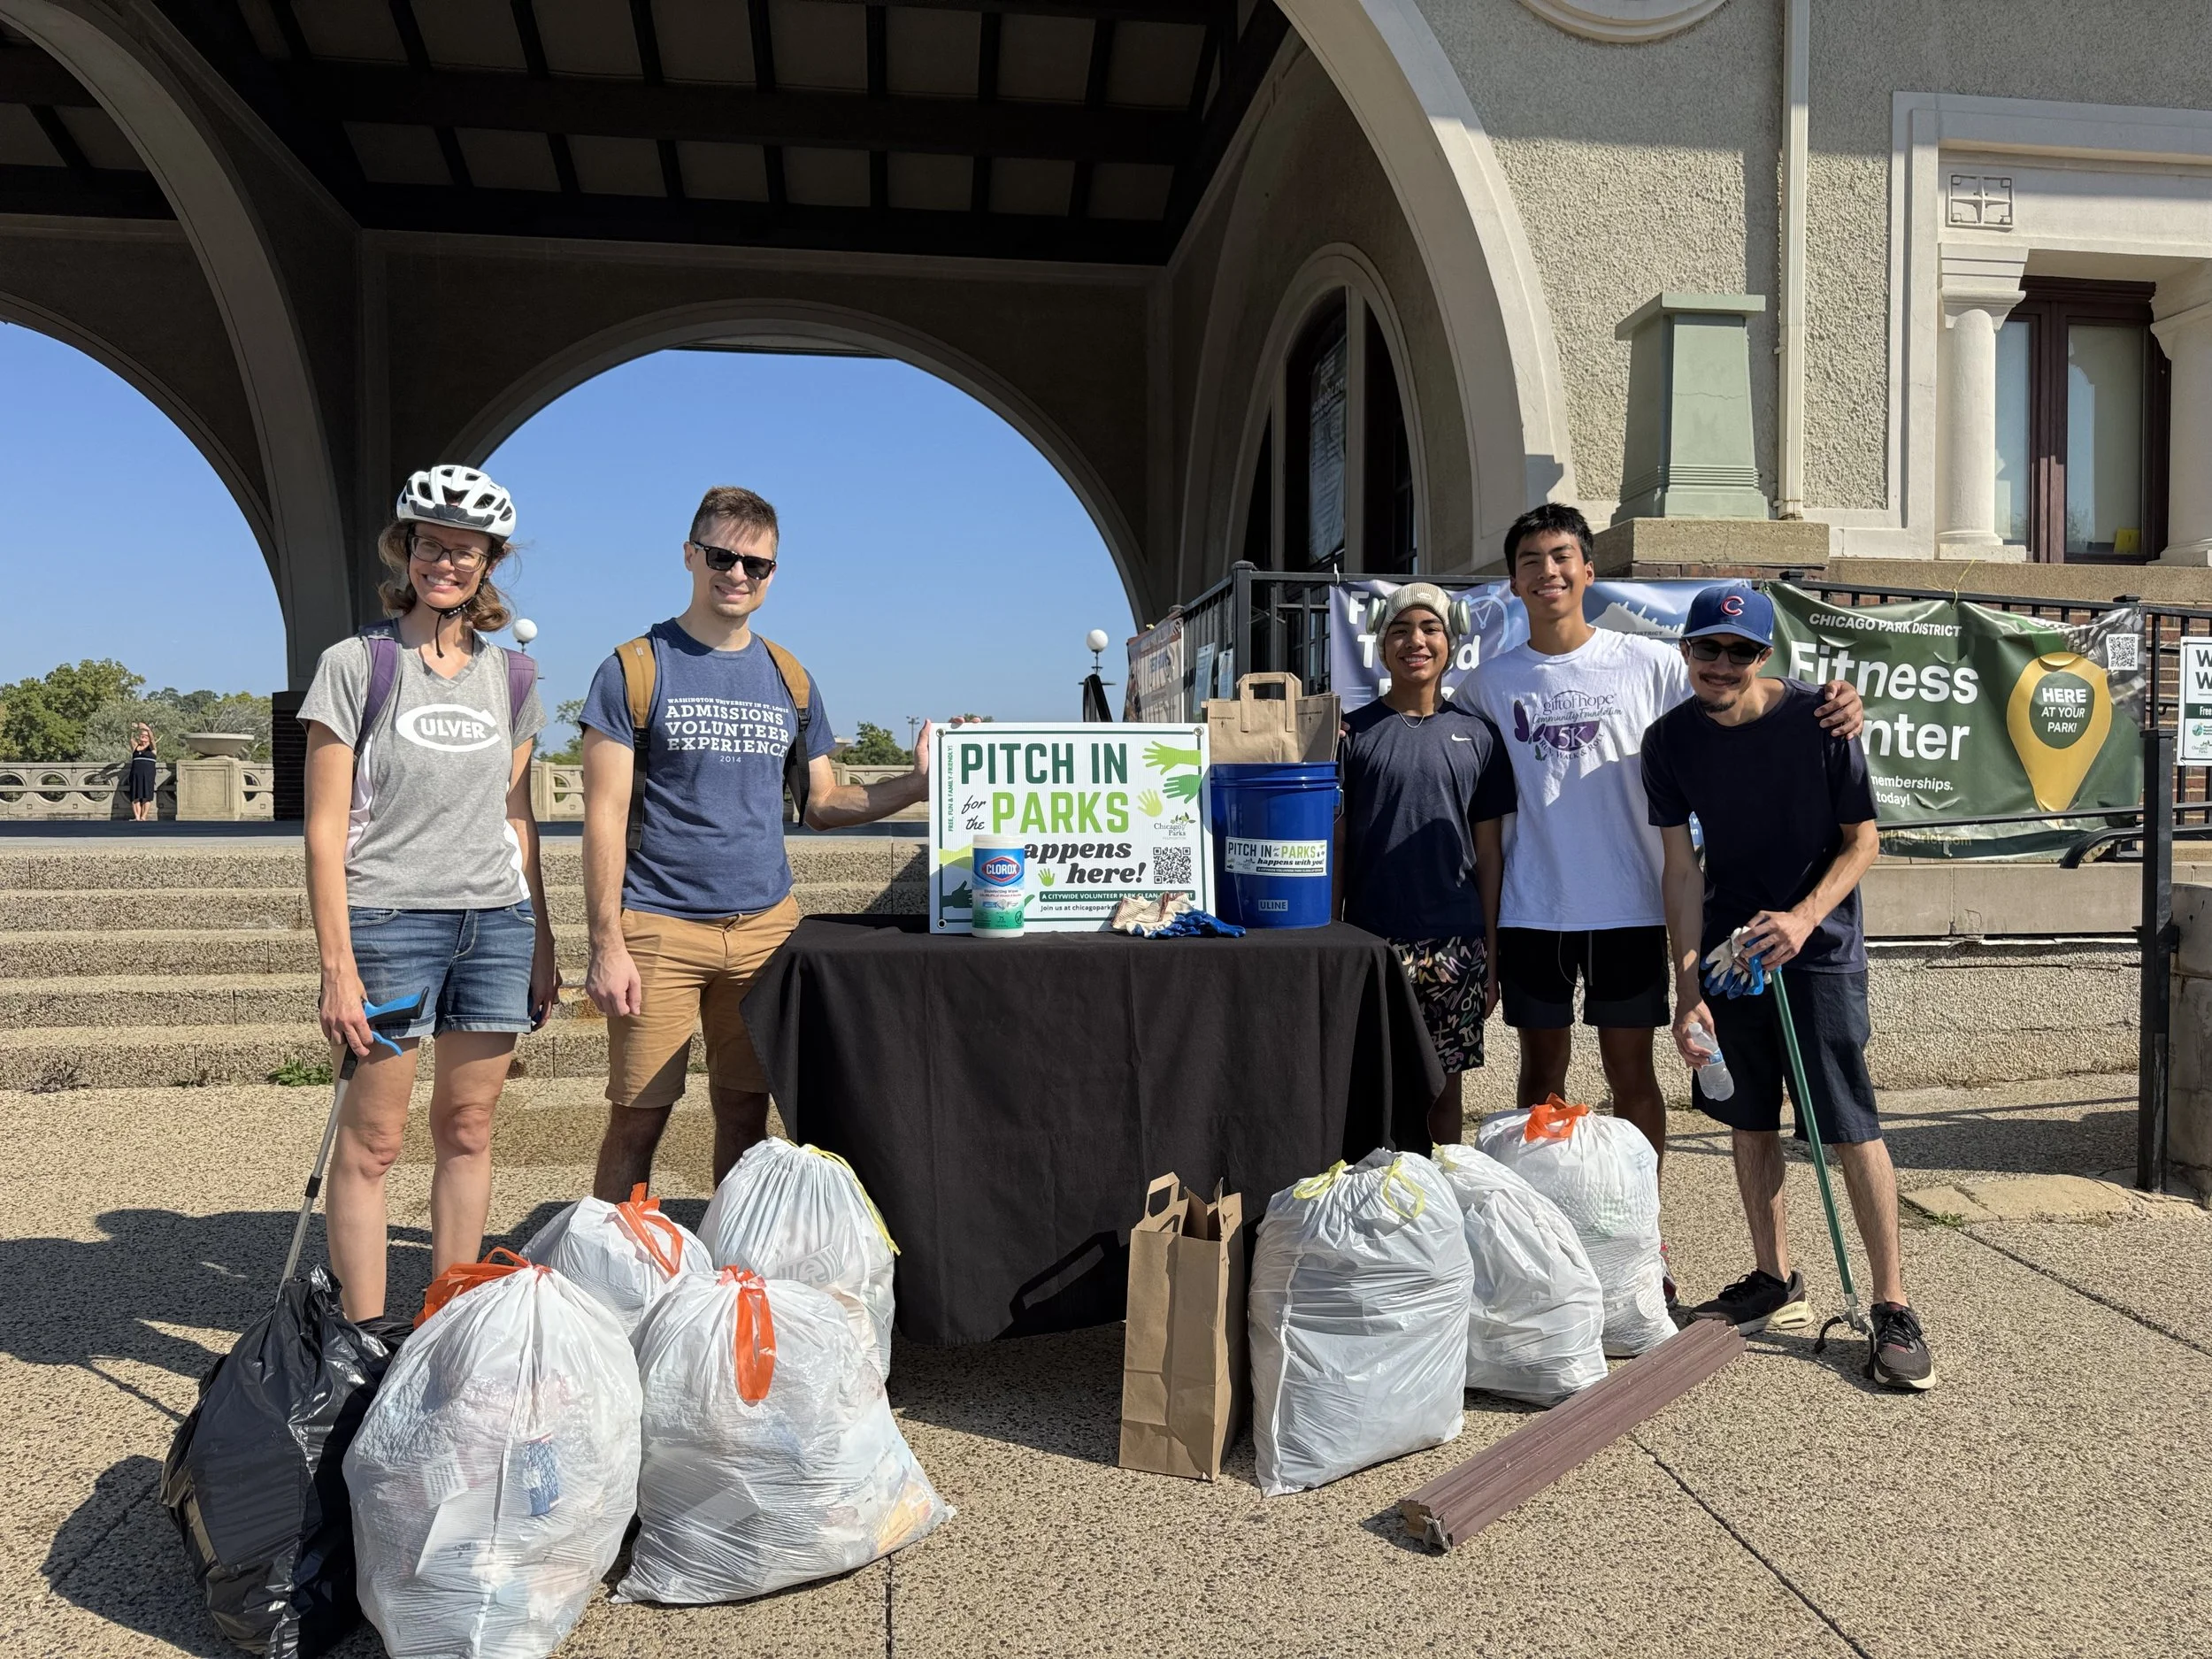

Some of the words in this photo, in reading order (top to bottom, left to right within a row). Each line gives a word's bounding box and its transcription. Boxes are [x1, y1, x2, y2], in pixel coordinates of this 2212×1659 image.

[1720, 595, 1745, 617] C
[1809, 613, 1876, 631] CHICAGO
[1878, 620, 1911, 634] PARK
[1911, 622, 1962, 637] DISTRICT
[1788, 640, 1979, 704] Fitness
[715, 698, 753, 707] UNIVERSITY
[2041, 687, 2086, 703] HERE
[664, 705, 784, 726] ADMISSIONS
[1532, 711, 1578, 725] Community
[1578, 707, 1623, 719] Foundation
[2041, 707, 2055, 718] AT
[2057, 707, 2085, 718] YOUR
[664, 721, 789, 743] VOLUNTEER
[1861, 713, 1970, 761] nter
[2047, 721, 2078, 733] PARK!
[666, 736, 788, 758] EXPERIENCE
[1555, 750, 1579, 760] WALK
[1579, 748, 1587, 757] &
[1587, 732, 1605, 752] ROLL
[1558, 726, 1587, 749] 5K
[719, 755, 741, 764] 2014
[961, 743, 1074, 785] PITCH
[1091, 743, 1128, 785] IN
[961, 795, 987, 814] for
[1875, 790, 1910, 808] today!
[965, 815, 985, 830] the
[992, 792, 1129, 833] PARKS
[1153, 822, 1182, 832] Chicago
[1024, 842, 1132, 864] appens
[1228, 841, 1257, 856] PITCH
[1261, 845, 1272, 858] IN
[1281, 845, 1316, 859] PARKS
[986, 864, 1018, 875] CLOROX
[1065, 862, 1147, 884] here!
